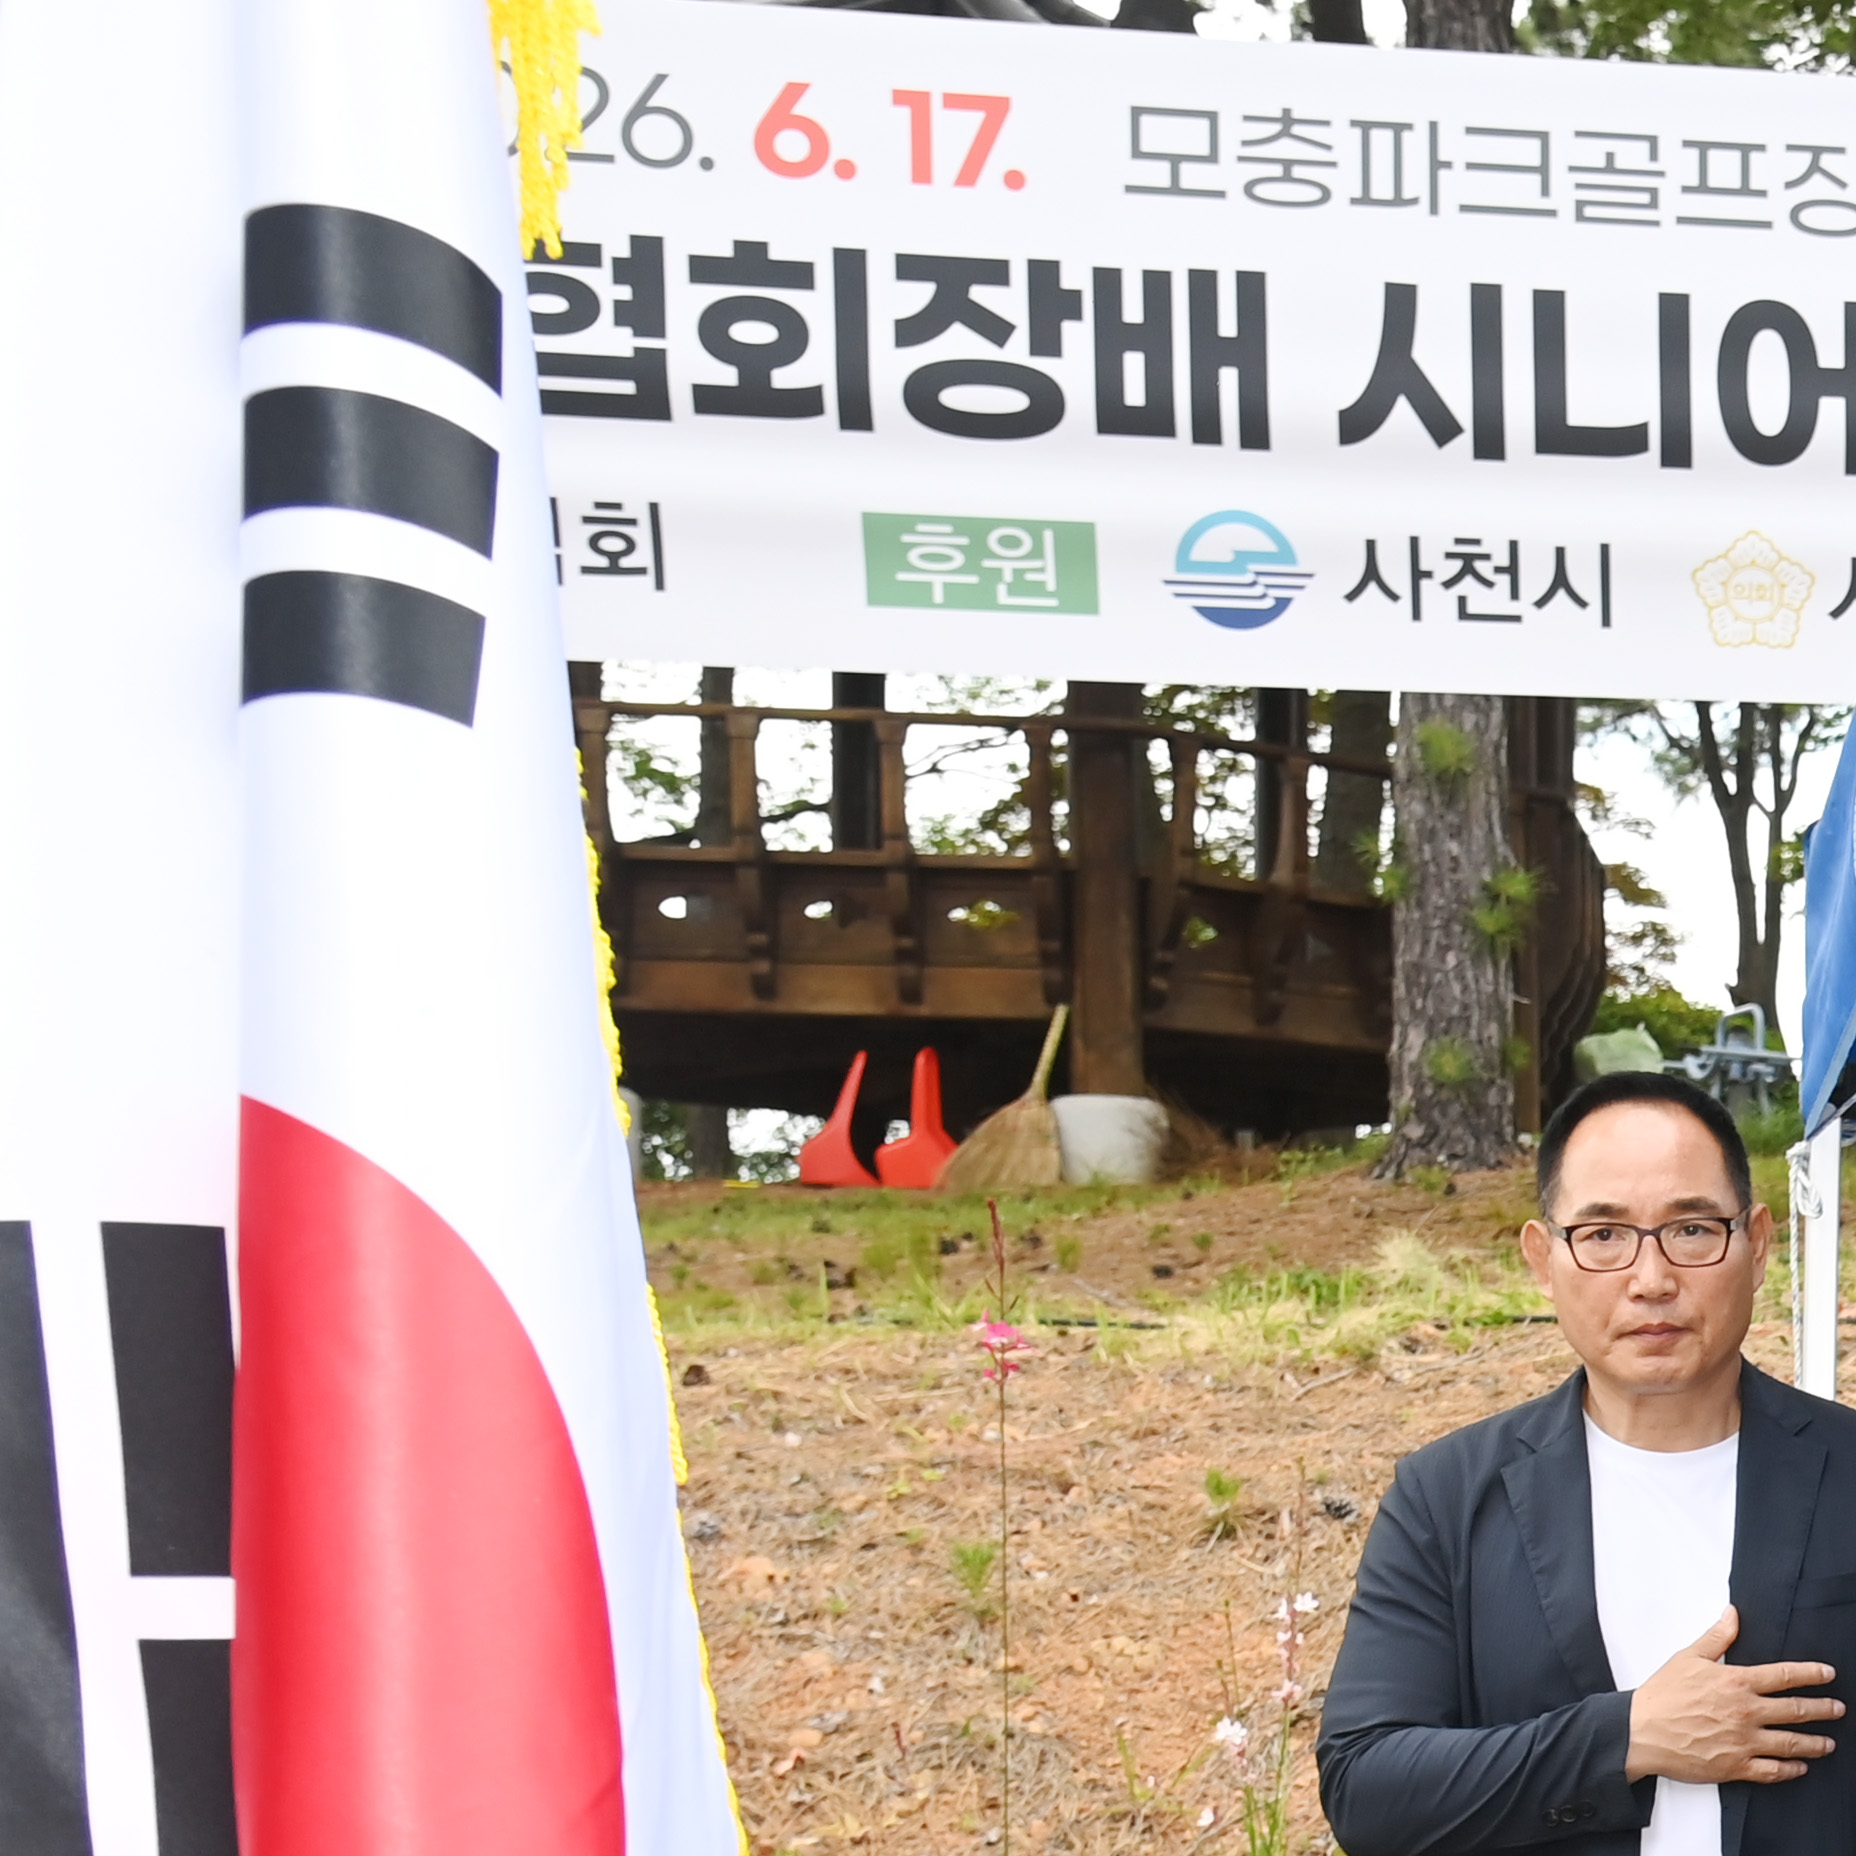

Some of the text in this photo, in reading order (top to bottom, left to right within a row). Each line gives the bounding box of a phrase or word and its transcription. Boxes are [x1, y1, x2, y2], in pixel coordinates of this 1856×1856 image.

[500, 60, 714, 171] 26.
[754, 82, 856, 180] 6.
[892, 89, 1026, 191] 17.
[523, 234, 1272, 453] 협회장배
[549, 496, 666, 592] 회
[895, 523, 1060, 607] 후원
[1342, 535, 1612, 629] 사천시
